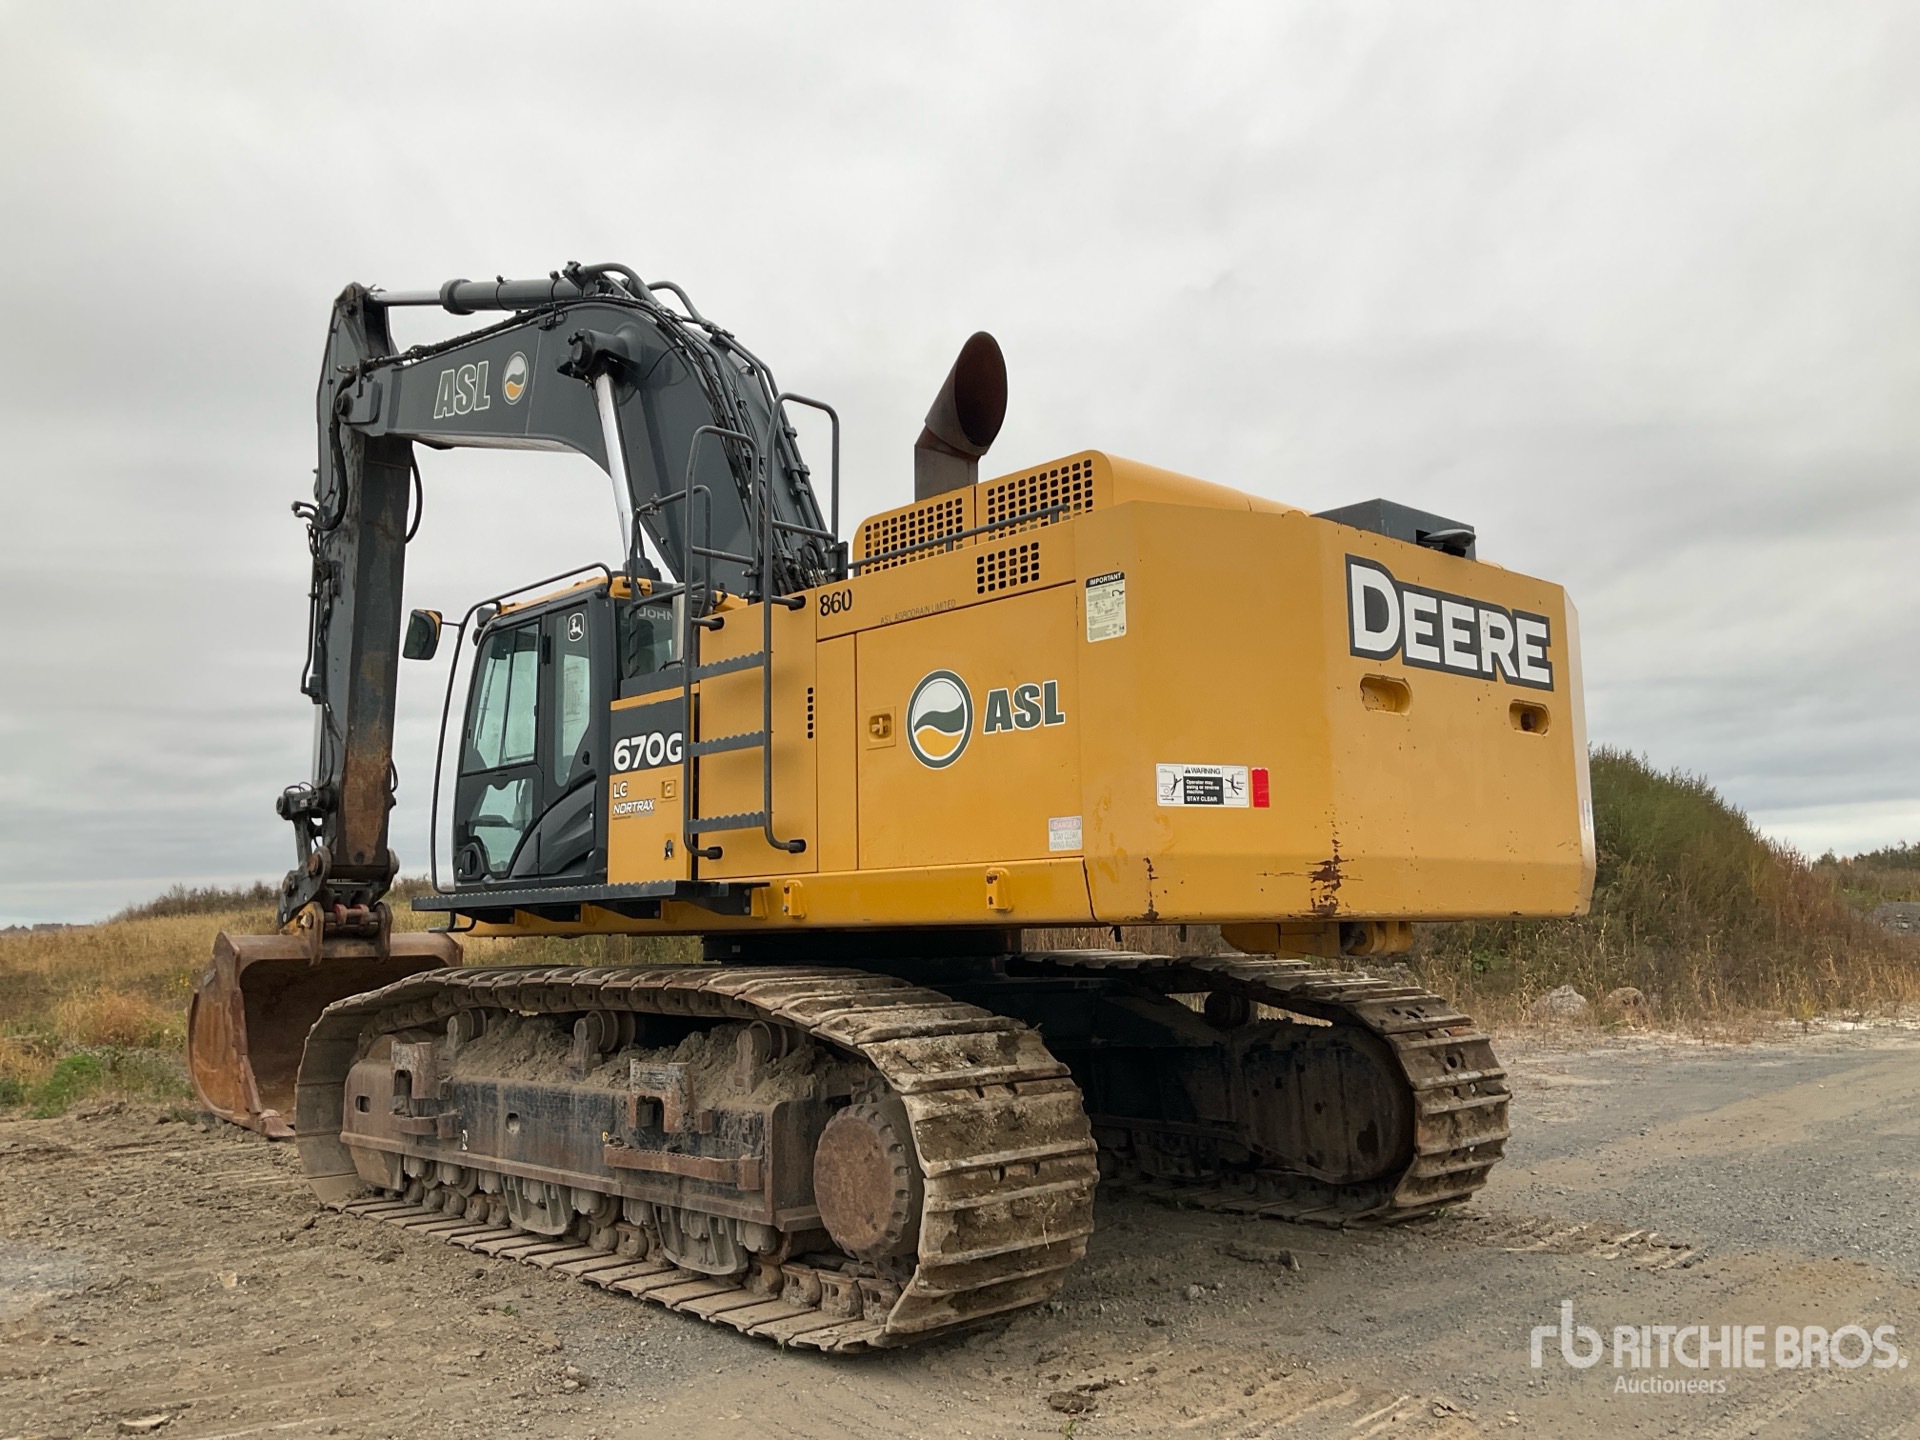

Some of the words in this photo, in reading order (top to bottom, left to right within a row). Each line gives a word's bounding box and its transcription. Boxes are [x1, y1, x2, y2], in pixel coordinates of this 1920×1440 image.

[433, 360, 490, 419] ASL
[1089, 573, 1122, 586] IMPORTANT
[820, 589, 852, 617] 860
[931, 599, 957, 613] LIMITED
[1350, 563, 1550, 683] DEERE
[983, 679, 1066, 735] ASL
[613, 732, 683, 771] 670G
[1190, 767, 1221, 775] WARNING
[613, 781, 628, 799] LC
[612, 799, 656, 815] NORTRAX
